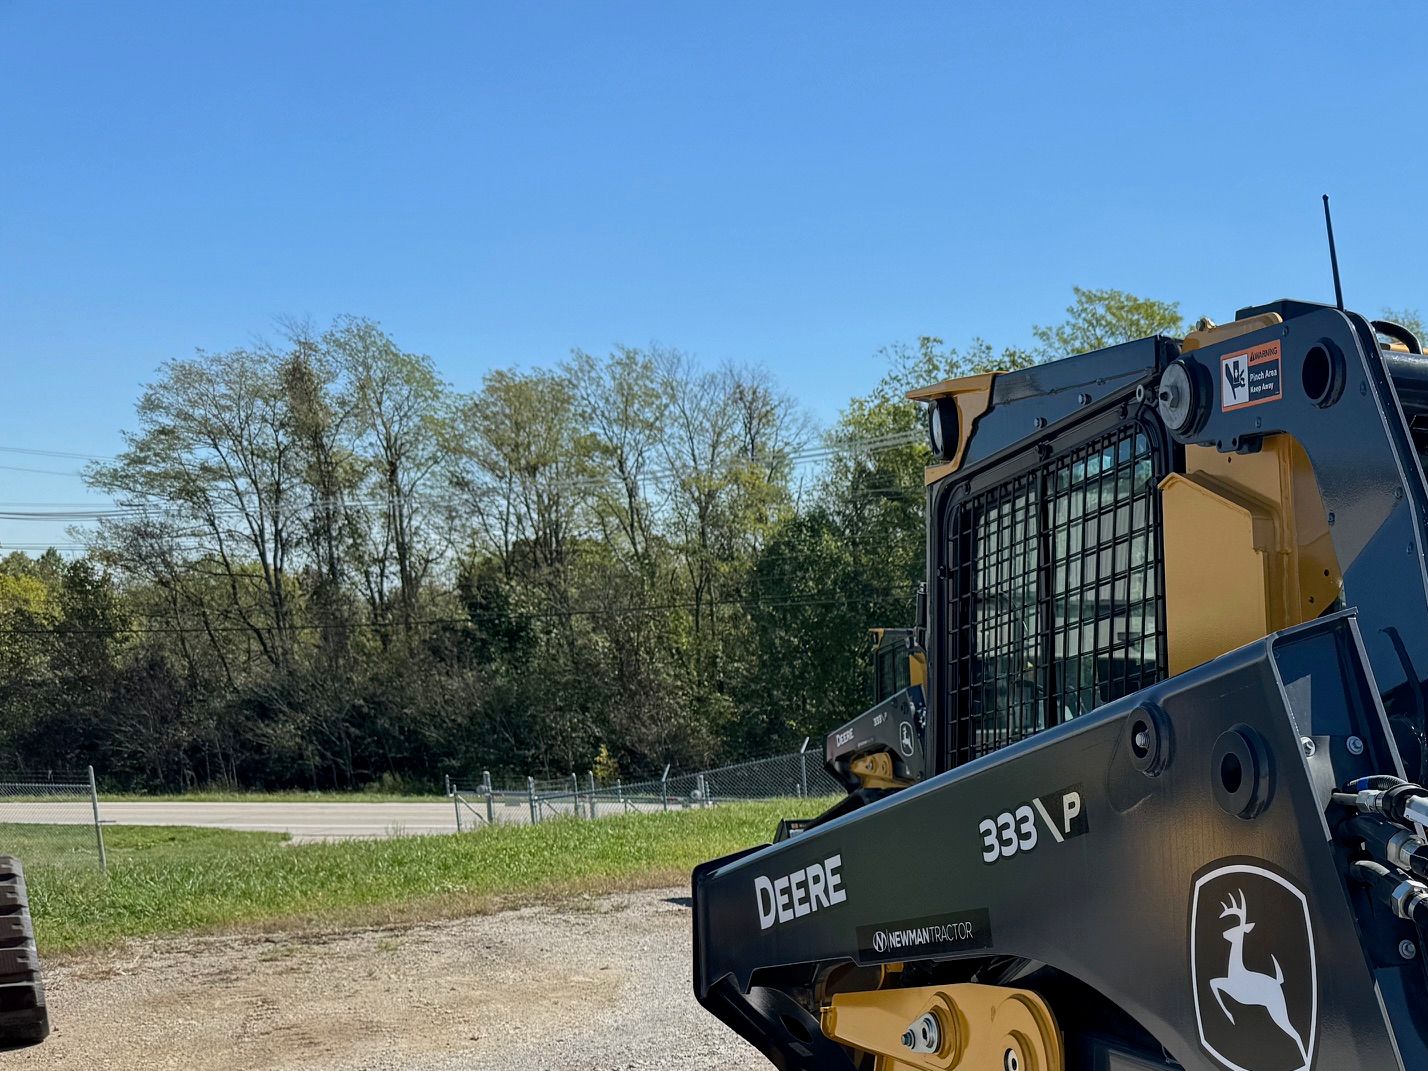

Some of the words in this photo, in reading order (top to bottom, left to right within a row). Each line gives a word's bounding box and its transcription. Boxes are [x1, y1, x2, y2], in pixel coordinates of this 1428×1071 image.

[1253, 347, 1277, 359] WARNING
[1250, 372, 1264, 381] Pinch
[1262, 382, 1274, 391] Away
[836, 728, 854, 747] DEERE
[754, 854, 847, 930] DEERE
